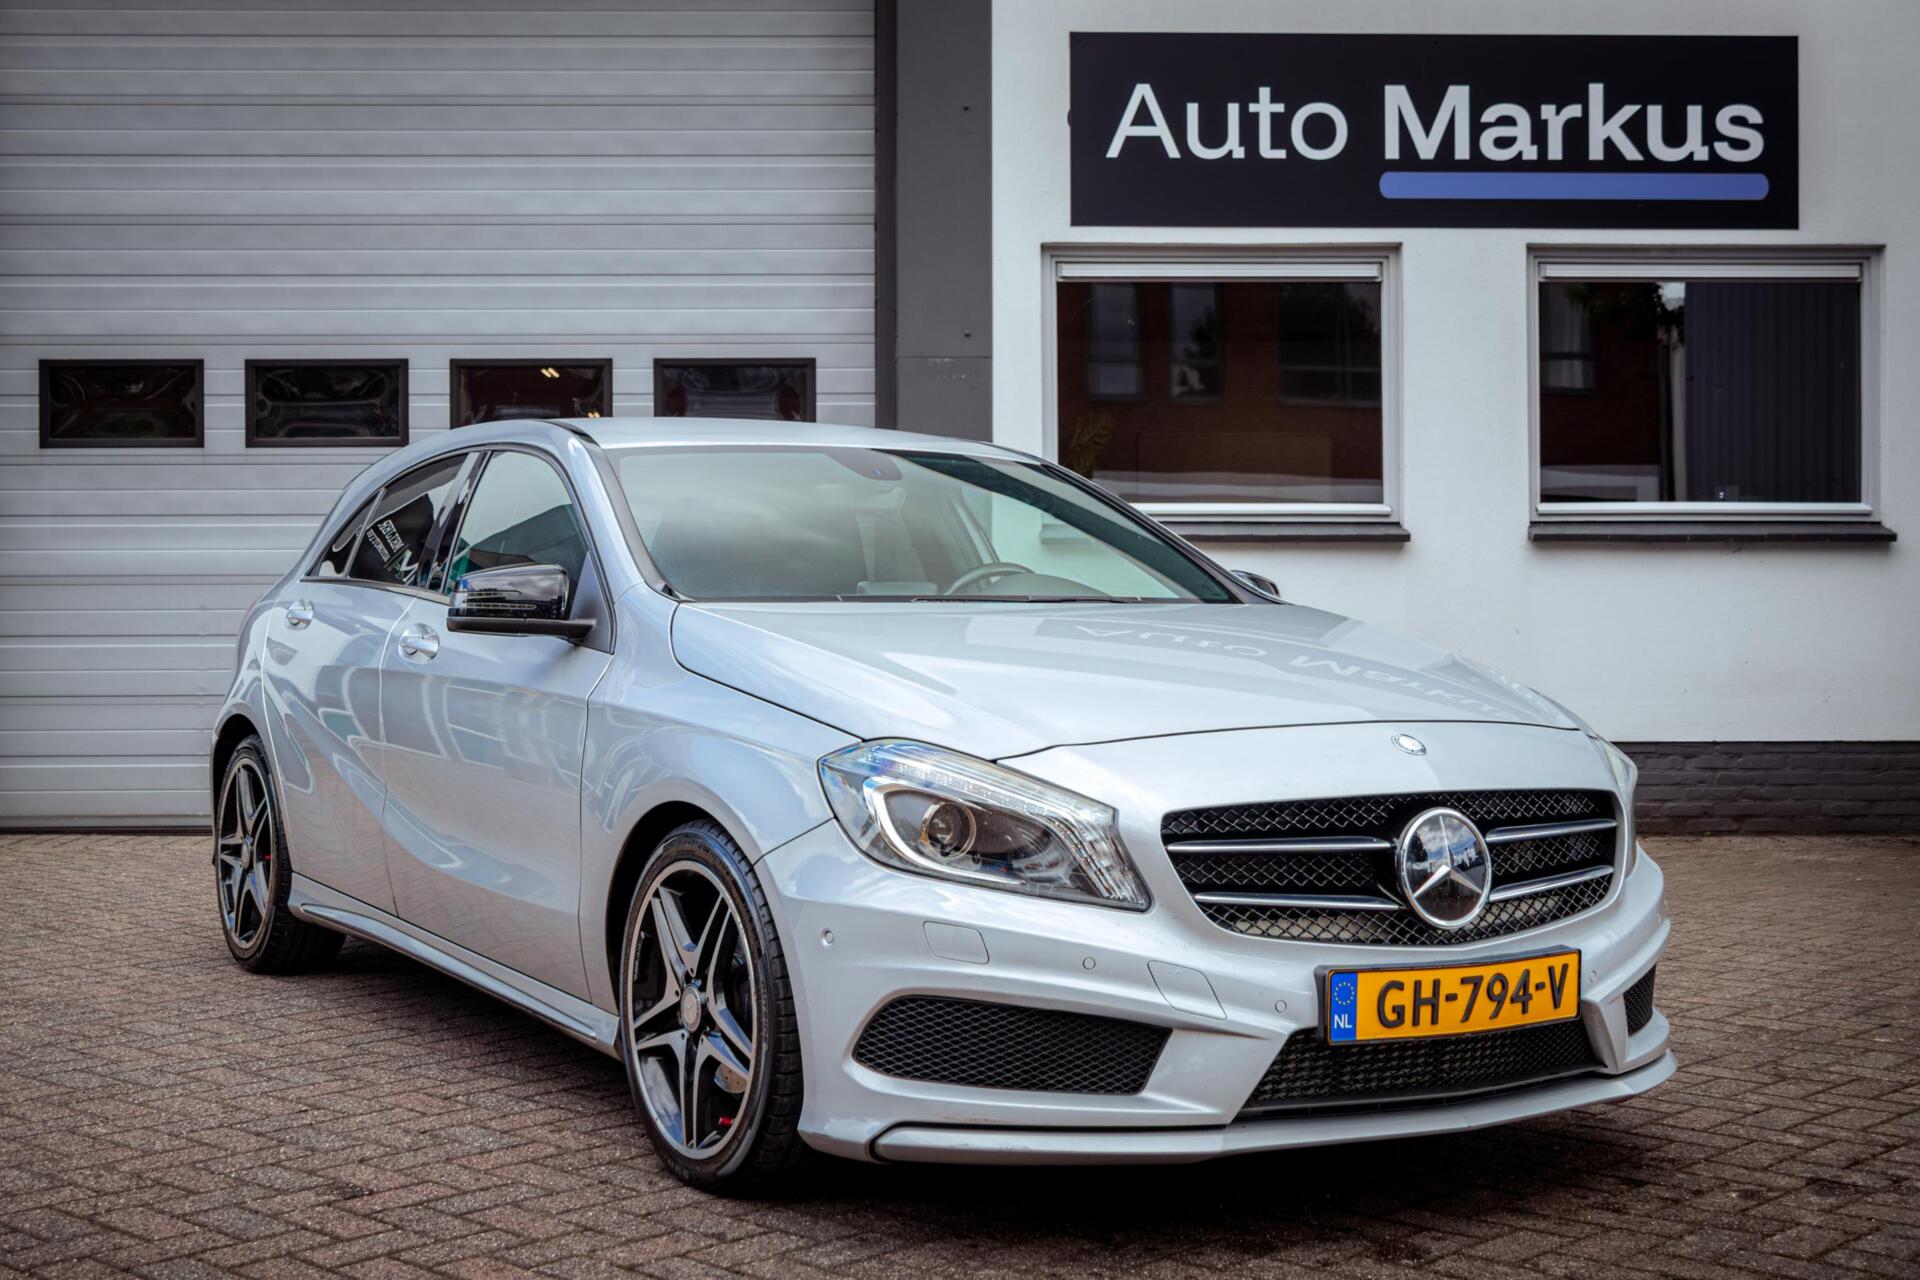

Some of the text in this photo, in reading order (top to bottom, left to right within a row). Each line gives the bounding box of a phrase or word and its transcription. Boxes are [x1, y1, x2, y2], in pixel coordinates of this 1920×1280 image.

[1105, 82, 1764, 162] Auto Markus
[1334, 1014, 1352, 1029] NL
[1377, 963, 1569, 1028] GH-794-V
